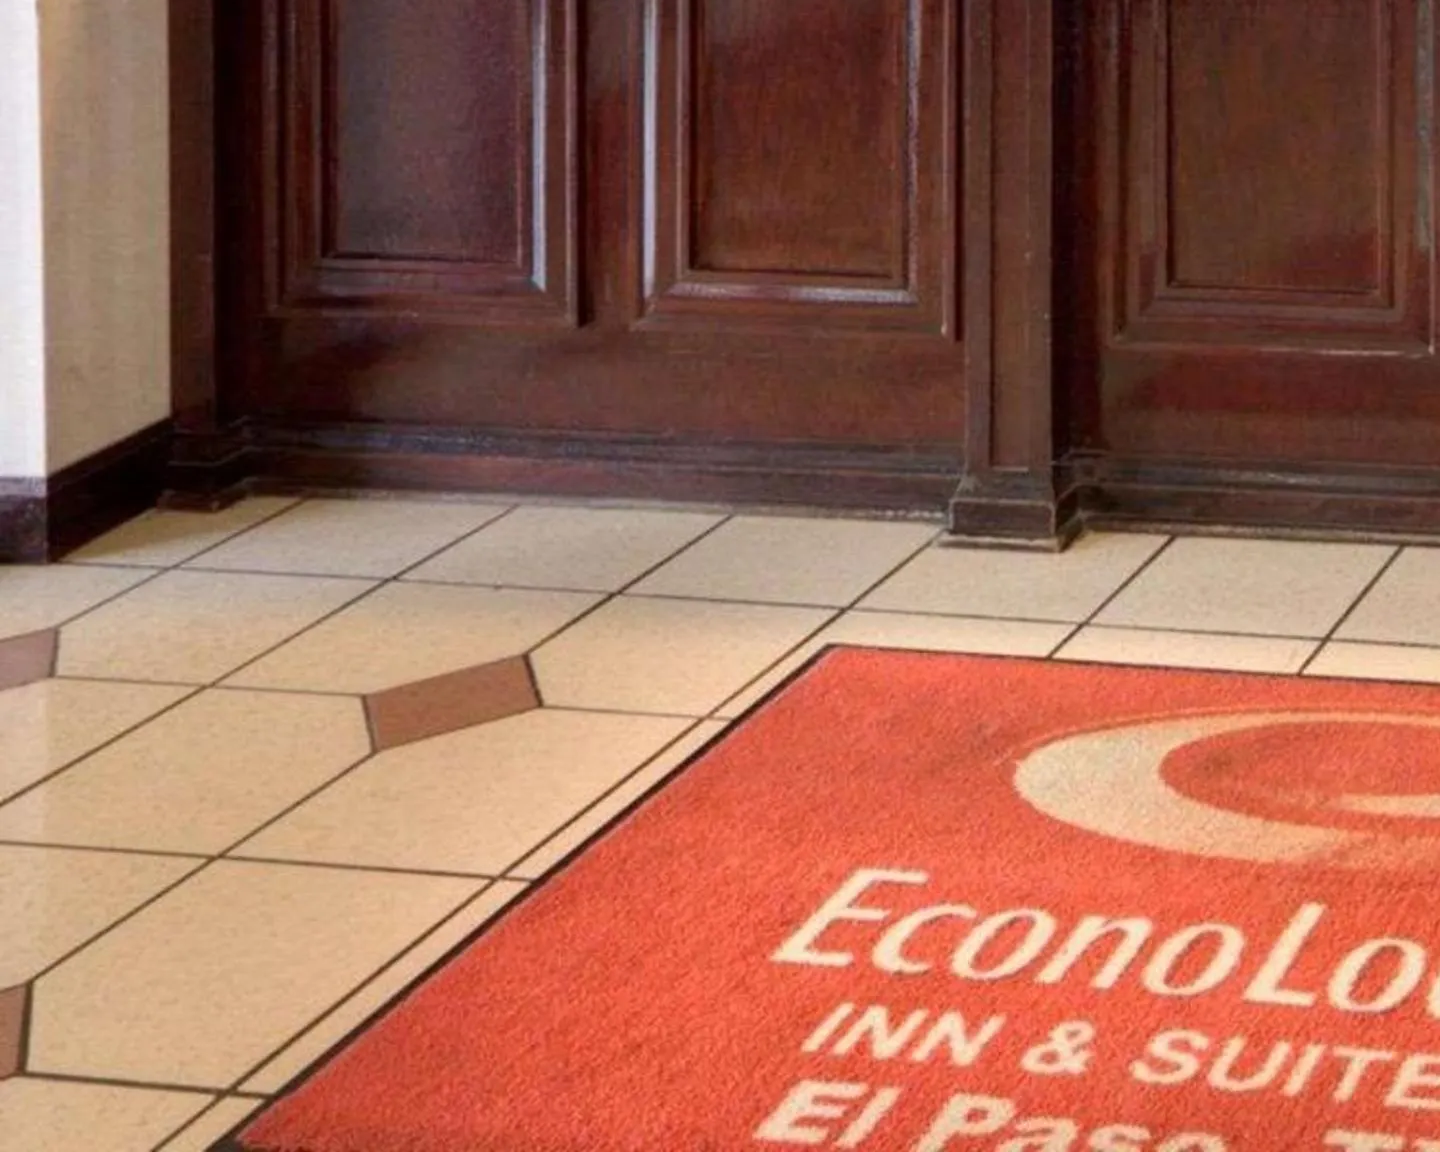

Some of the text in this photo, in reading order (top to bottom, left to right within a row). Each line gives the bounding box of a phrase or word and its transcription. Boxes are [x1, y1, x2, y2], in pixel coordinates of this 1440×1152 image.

[801, 1001, 1006, 1067] INN
[1019, 1019, 1097, 1075] &
[751, 1078, 902, 1149] El
